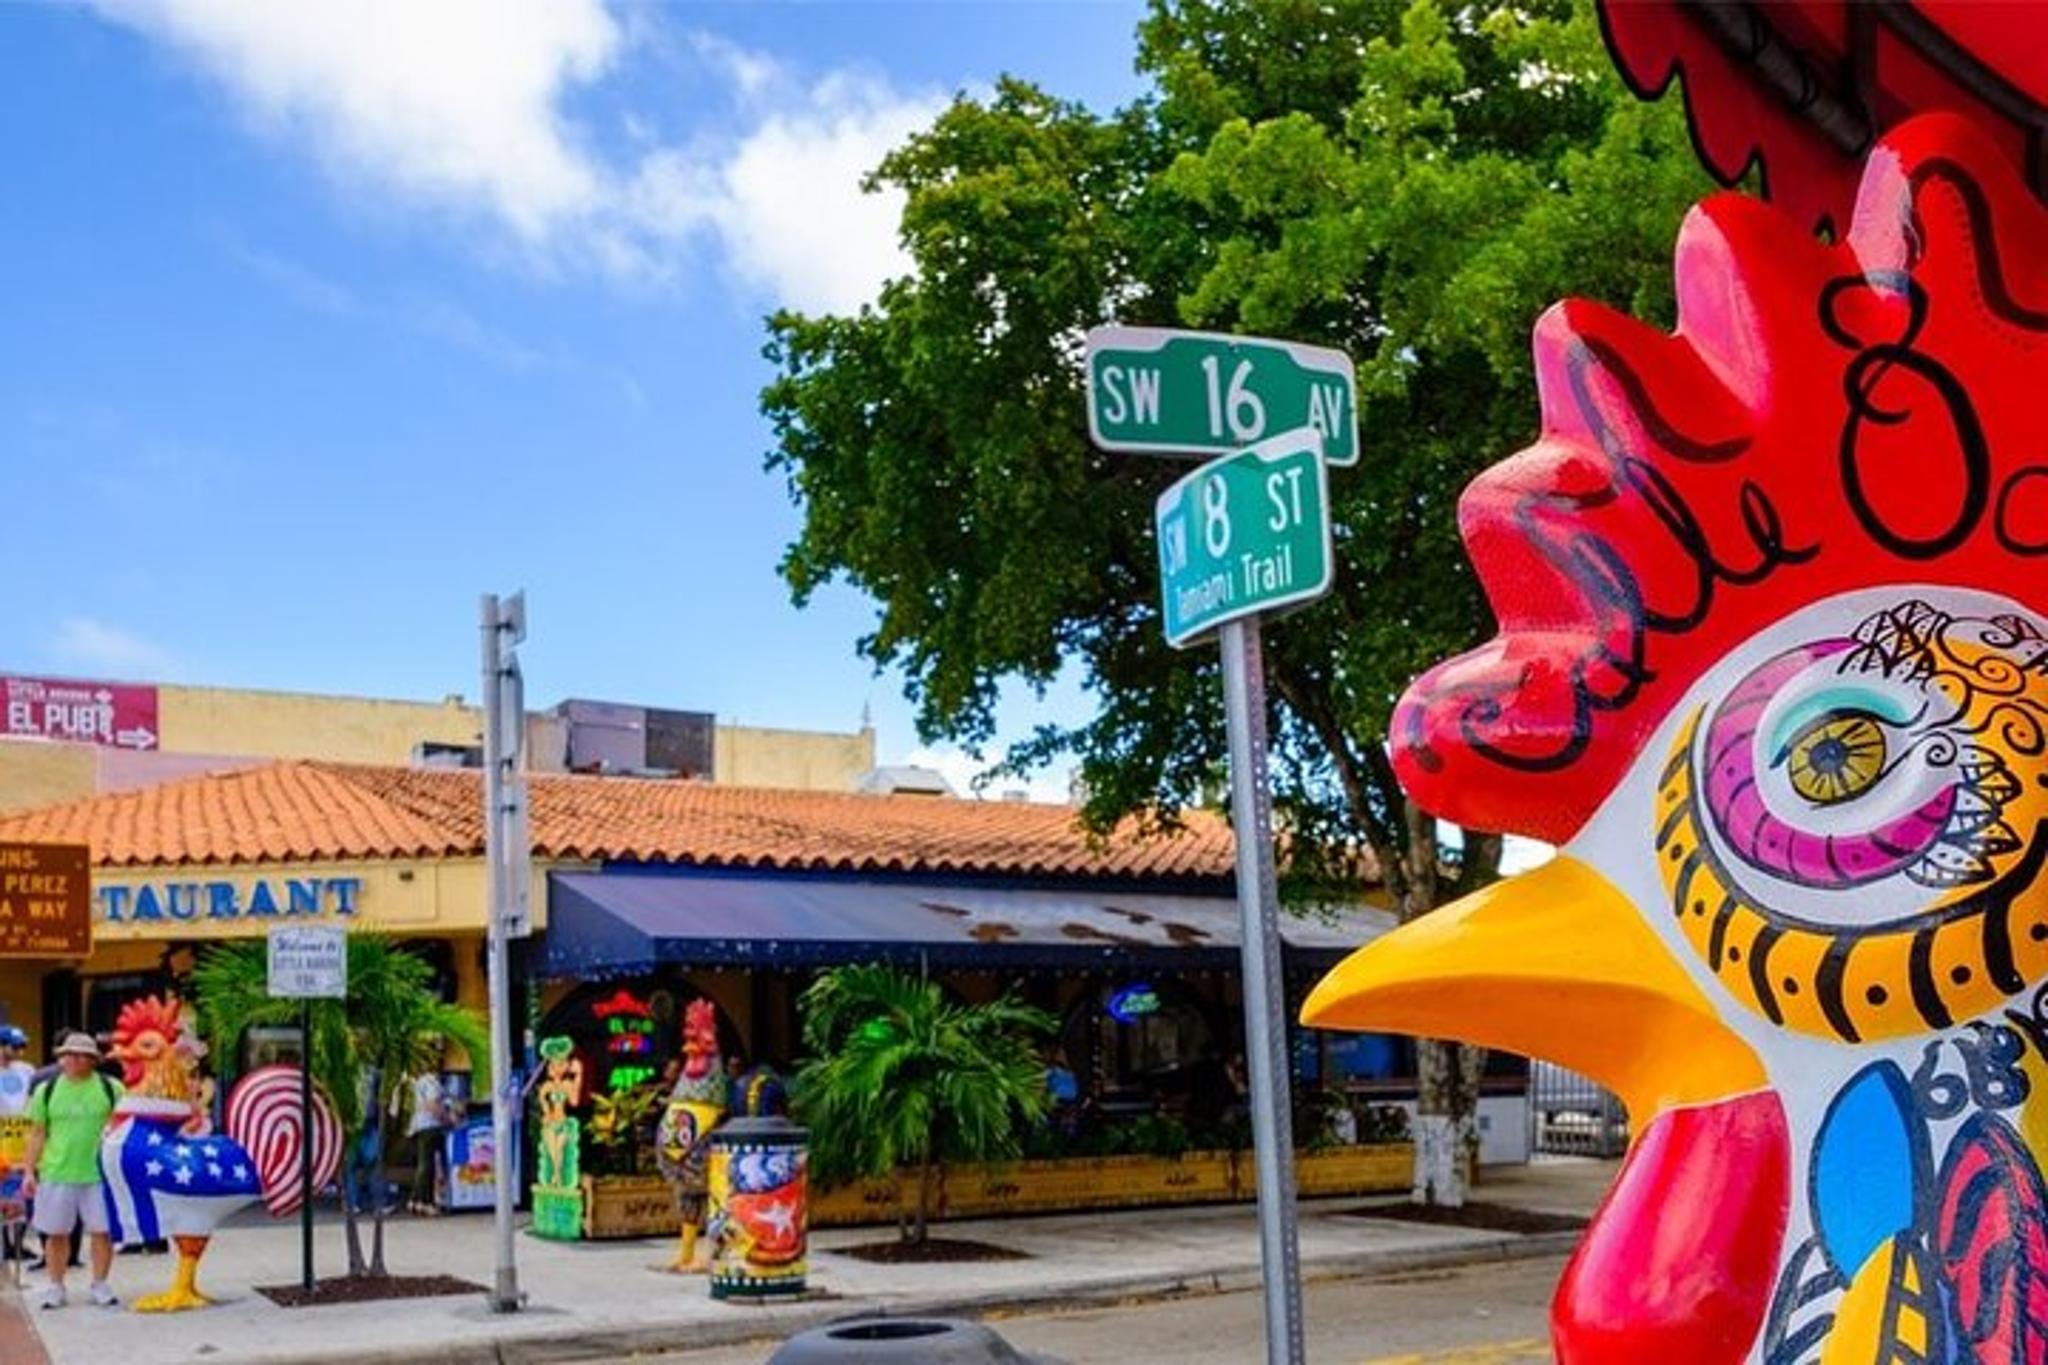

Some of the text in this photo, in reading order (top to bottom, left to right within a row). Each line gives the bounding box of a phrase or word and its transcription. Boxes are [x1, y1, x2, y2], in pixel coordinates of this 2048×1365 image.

[1102, 355, 1343, 441] SW 16 AV
[1165, 467, 1303, 577] SW 8 ST
[1240, 543, 1293, 597] Trail
[8, 701, 96, 736] EL PUB
[5, 873, 69, 895] PEREZ
[99, 877, 361, 923] TAURANT
[28, 900, 68, 919] WAY
